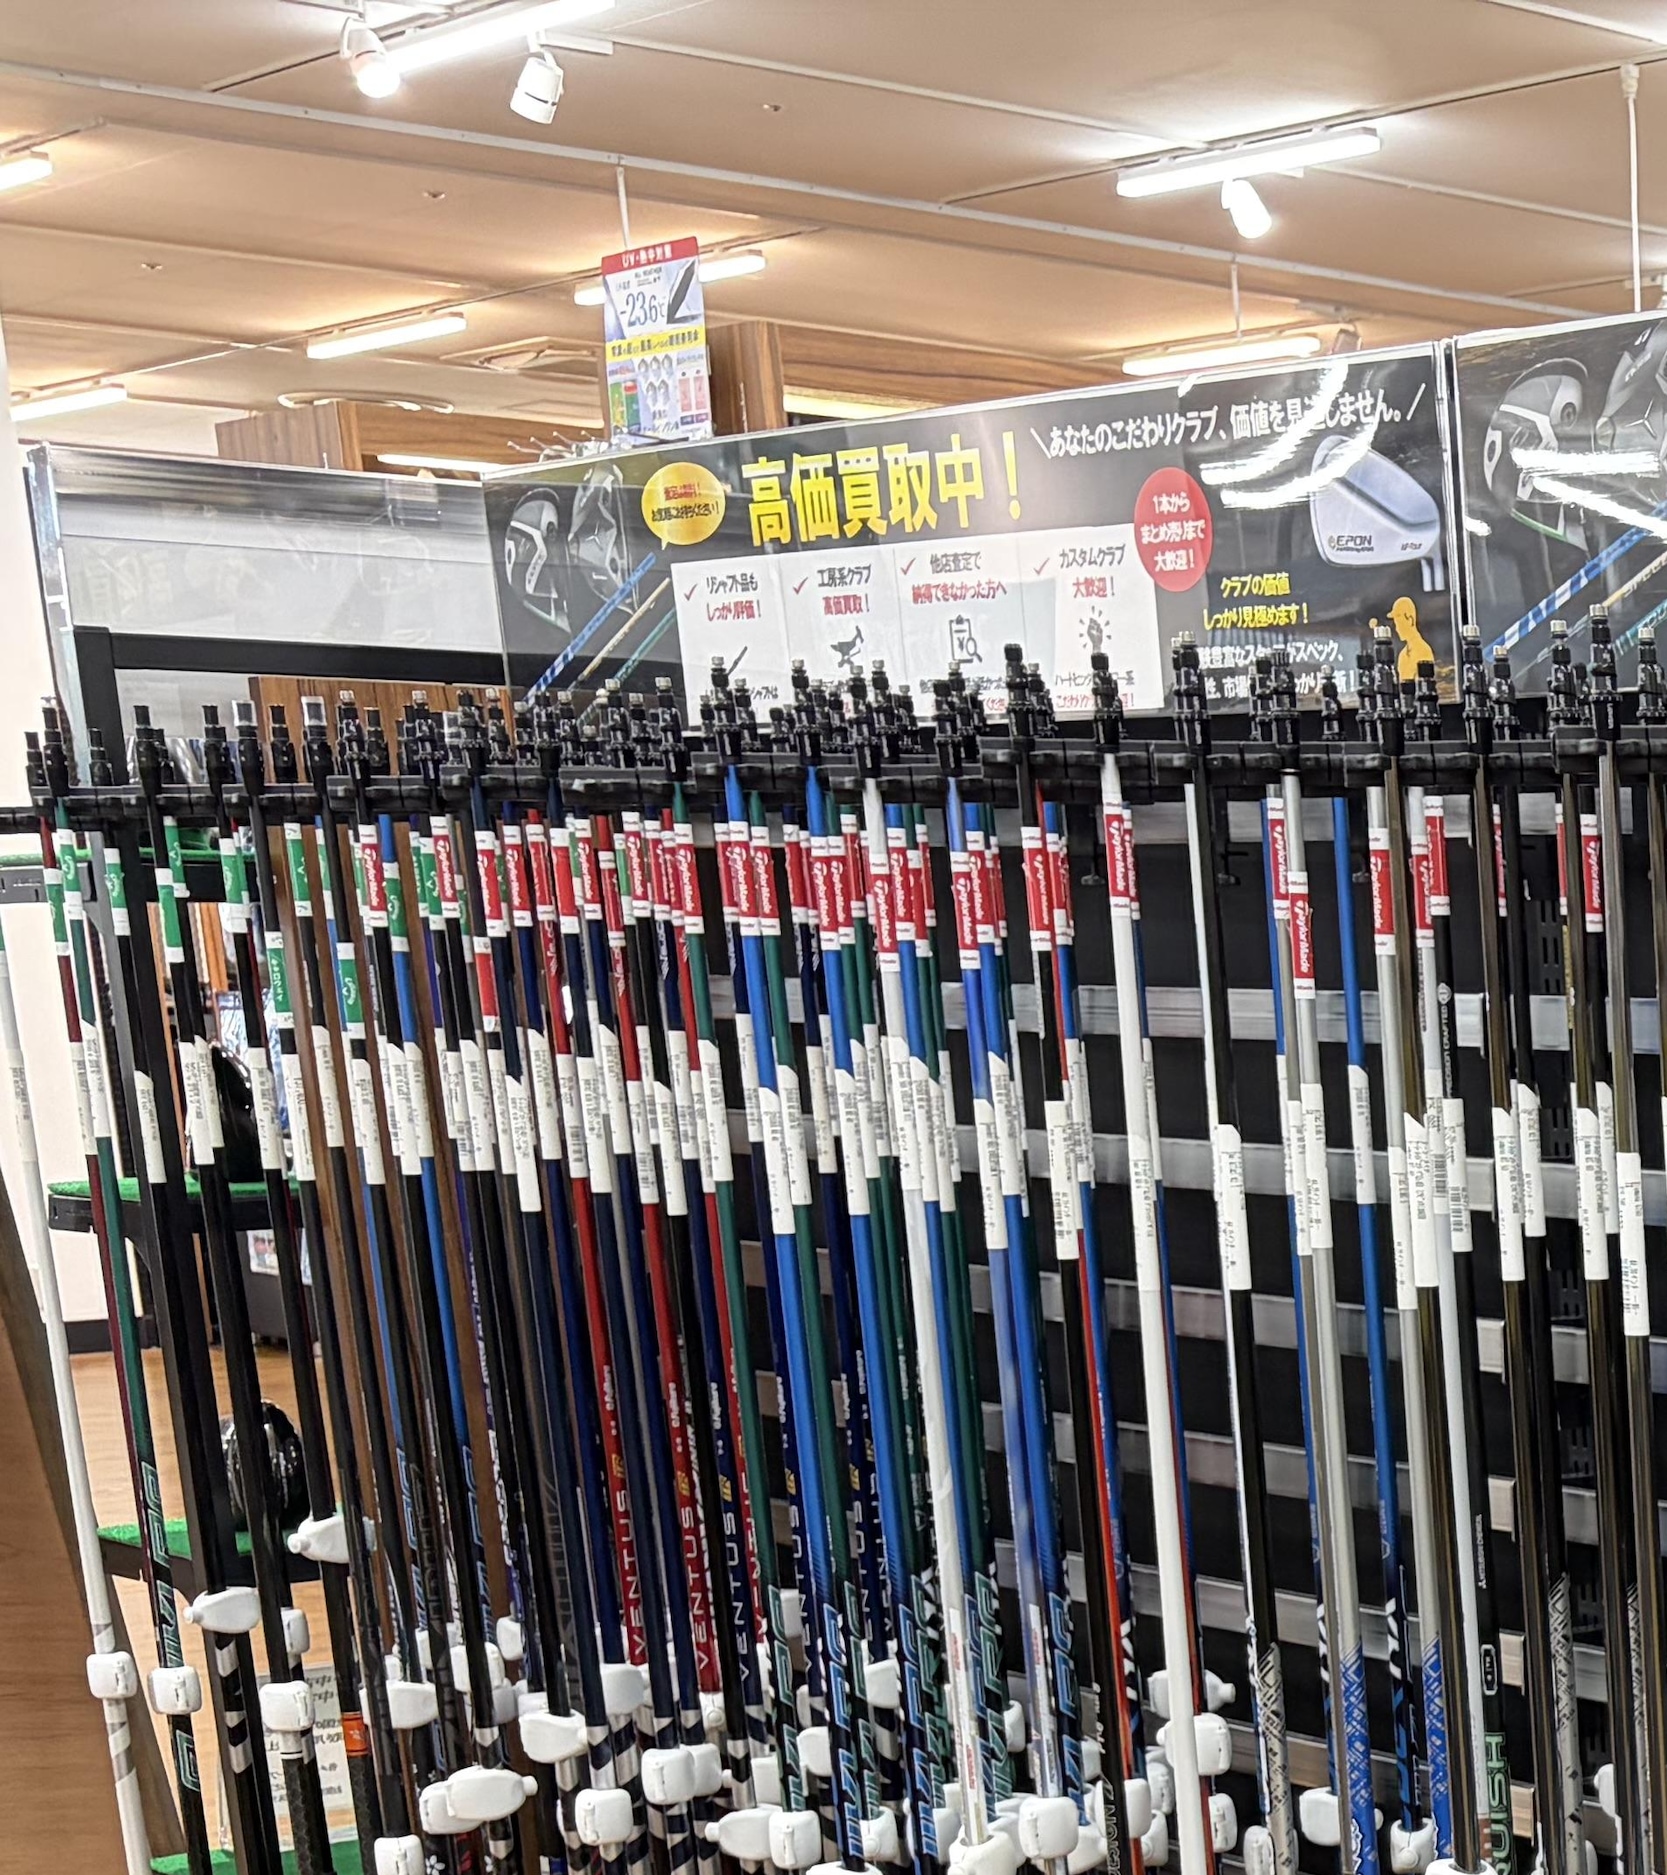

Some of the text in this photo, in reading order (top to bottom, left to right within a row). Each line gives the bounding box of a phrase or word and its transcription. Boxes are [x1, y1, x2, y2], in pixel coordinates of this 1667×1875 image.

[1048, 389, 1401, 459] あなたのこだわりクラブ、価値を見しません。
[742, 431, 1021, 546] 高価買取中！
[1203, 602, 1309, 631] しっかり見極めます！
[1221, 572, 1291, 598] クラブの価値
[615, 1488, 647, 1656] VENTUS
[680, 1507, 710, 1670] VENTUS
[721, 1512, 750, 1683] VENTUS
